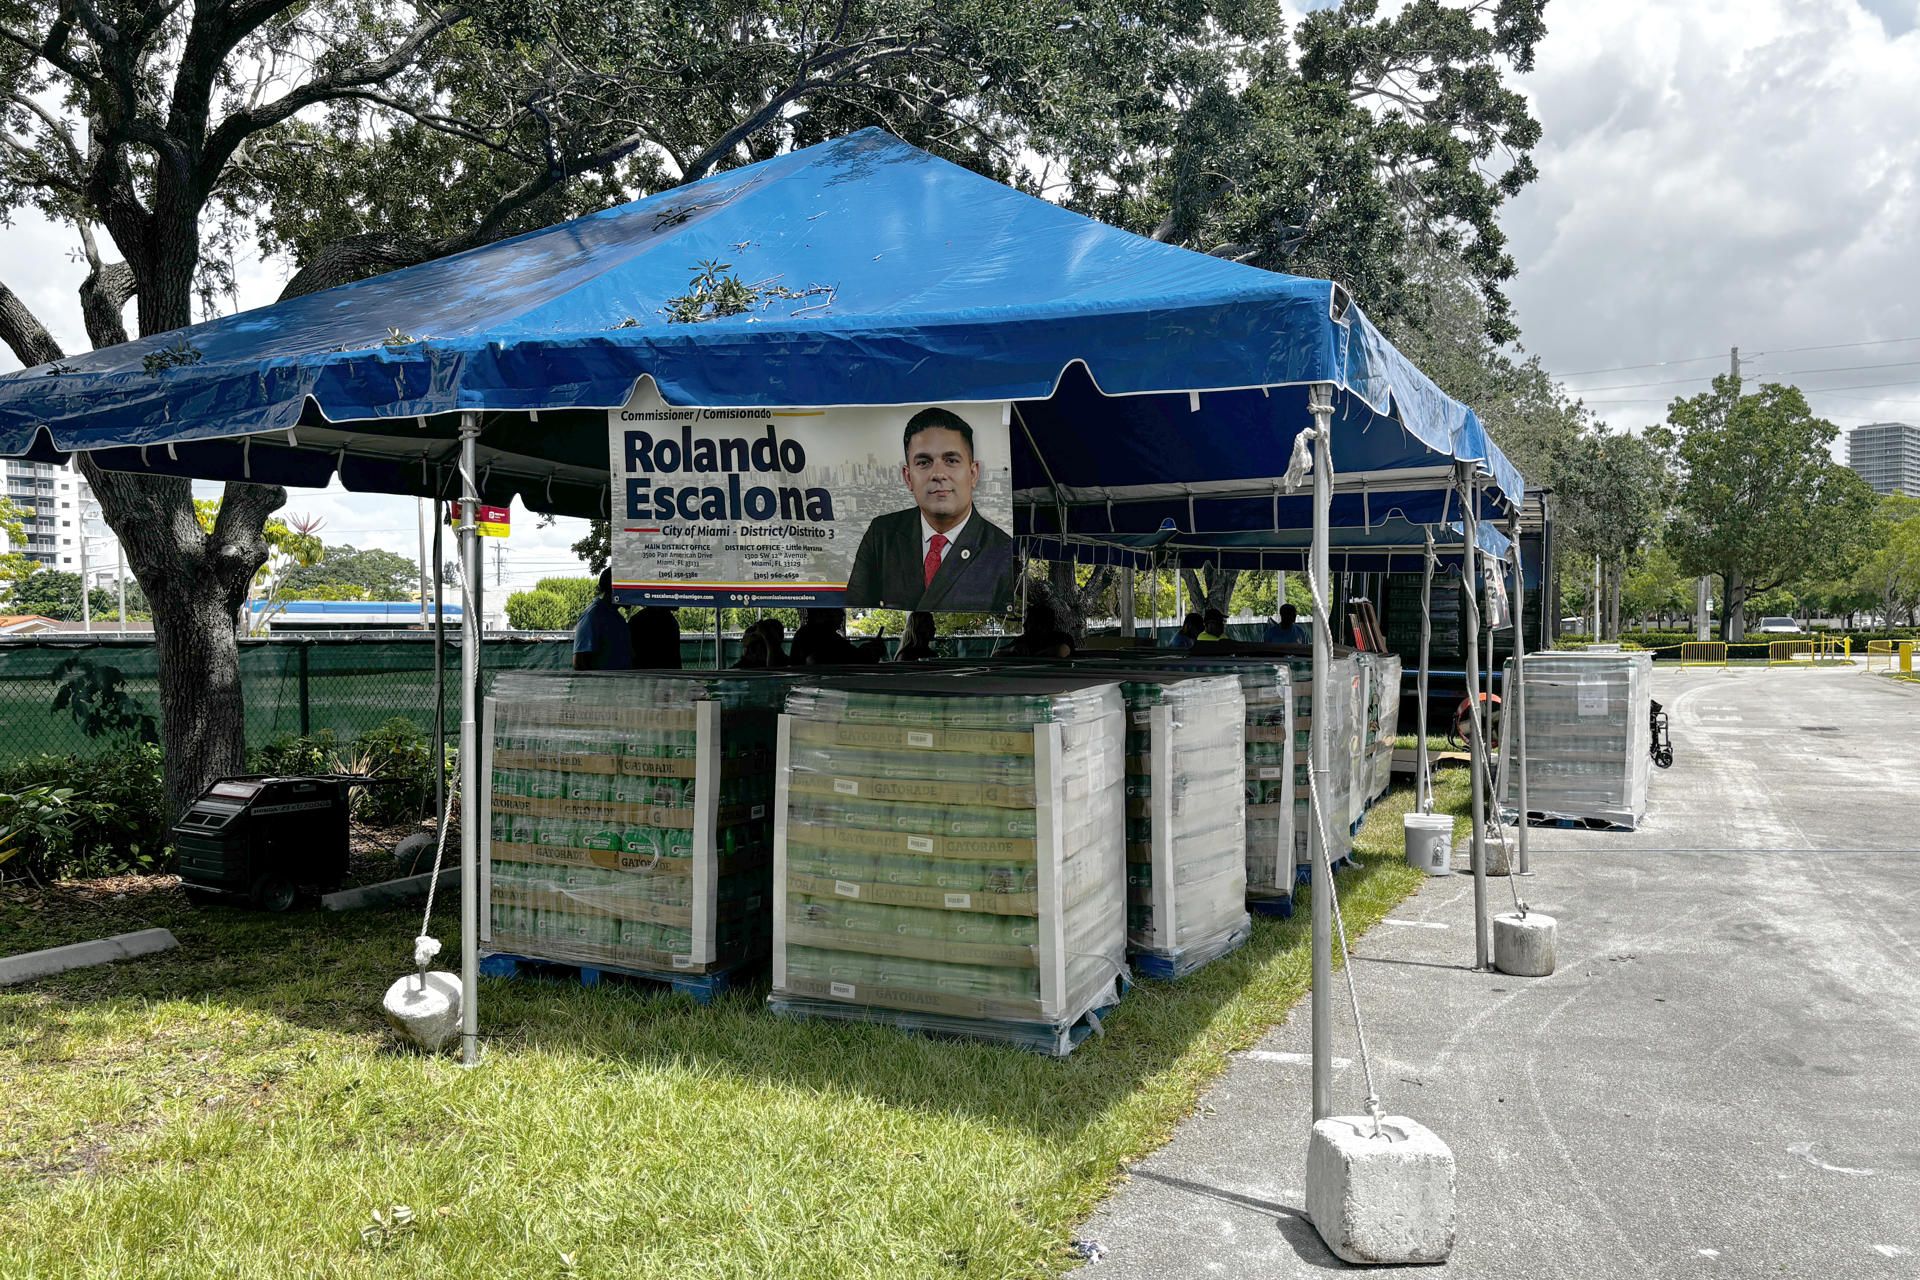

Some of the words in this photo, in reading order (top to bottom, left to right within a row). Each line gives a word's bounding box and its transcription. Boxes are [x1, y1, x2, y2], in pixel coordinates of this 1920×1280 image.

[620, 410, 695, 422] Commissioner
[695, 408, 702, 423] /
[703, 409, 772, 420] Comisionado
[624, 424, 806, 474] Rolando
[626, 473, 835, 522] Escalona
[661, 525, 684, 538] City
[684, 524, 697, 539] of
[697, 525, 730, 537] Miami
[740, 525, 826, 539] District/Distrito
[828, 528, 835, 540] 3
[753, 571, 769, 580] (305)
[839, 730, 902, 744] GATORADE
[874, 783, 936, 796] GATORADE
[492, 798, 531, 810] ATORADE
[535, 847, 585, 860] GATORADE
[946, 840, 1014, 853] GATORADE
[875, 989, 941, 1006] GATORADE
